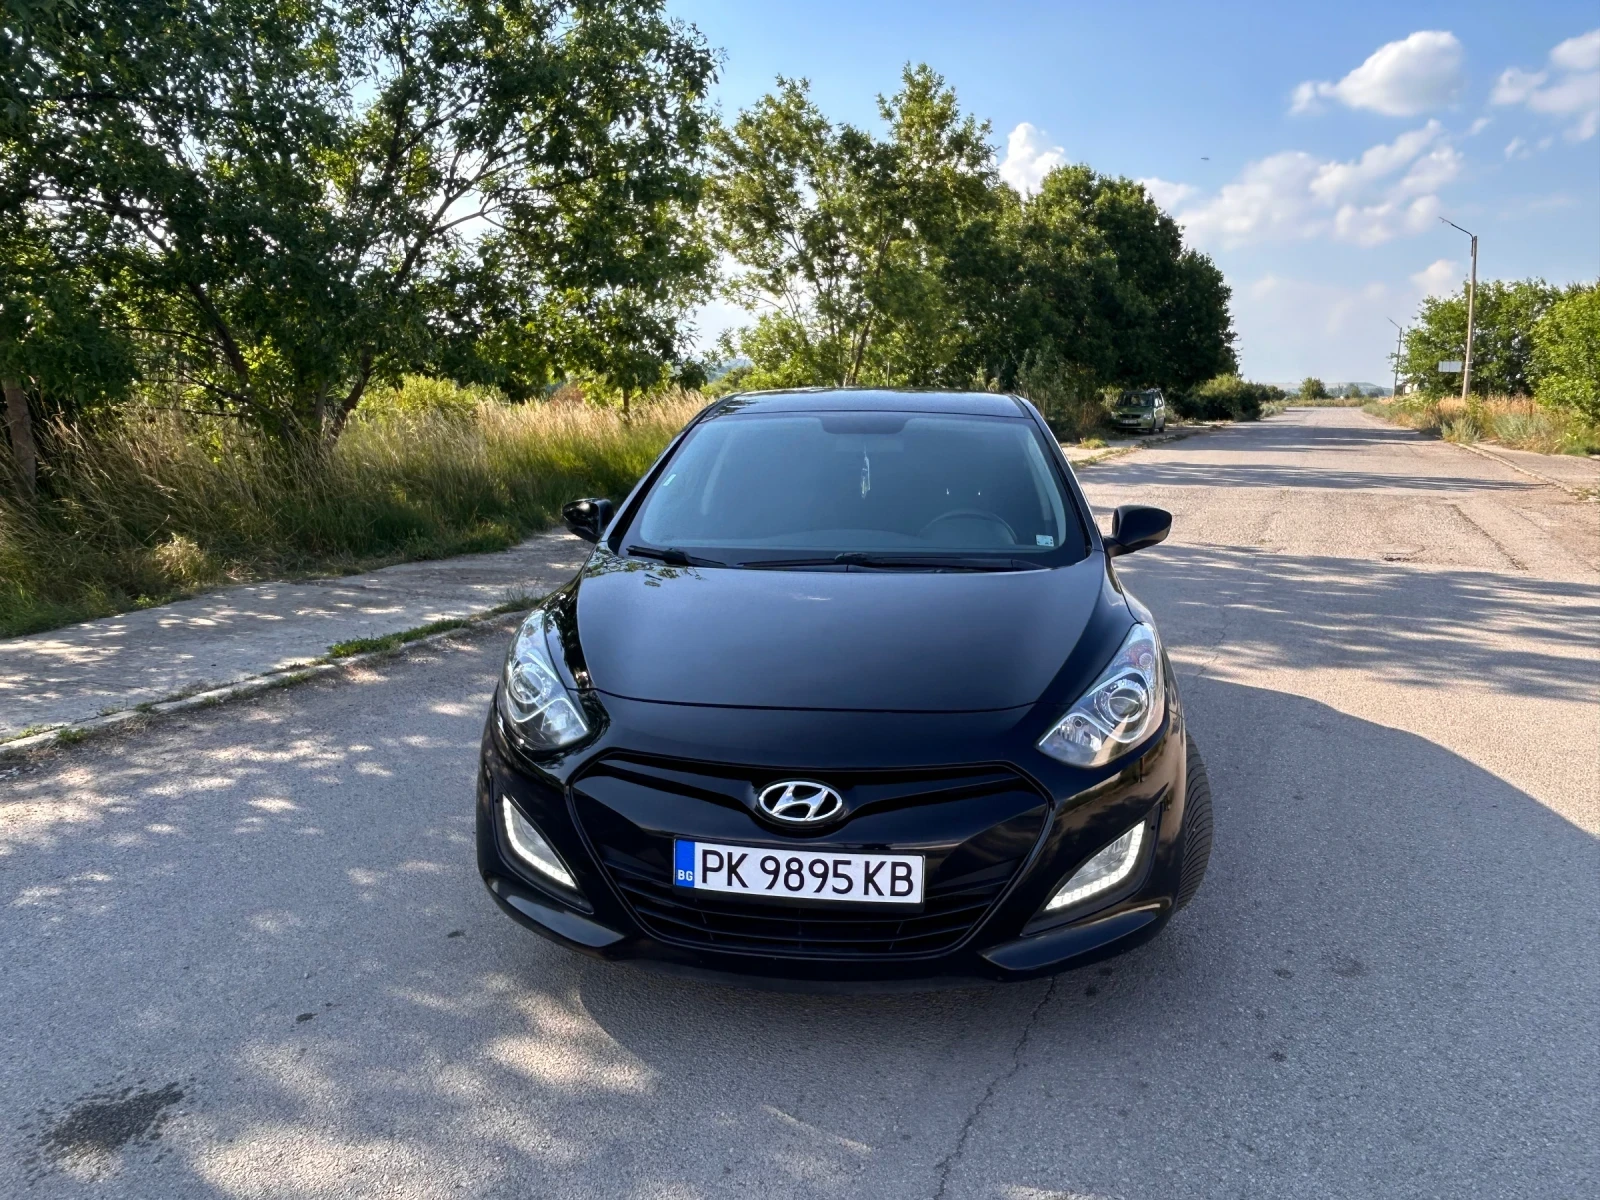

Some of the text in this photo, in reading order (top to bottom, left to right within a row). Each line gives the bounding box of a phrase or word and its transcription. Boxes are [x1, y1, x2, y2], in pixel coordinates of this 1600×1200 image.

[677, 869, 694, 882] BG
[701, 848, 914, 897] PK 9895 KB
